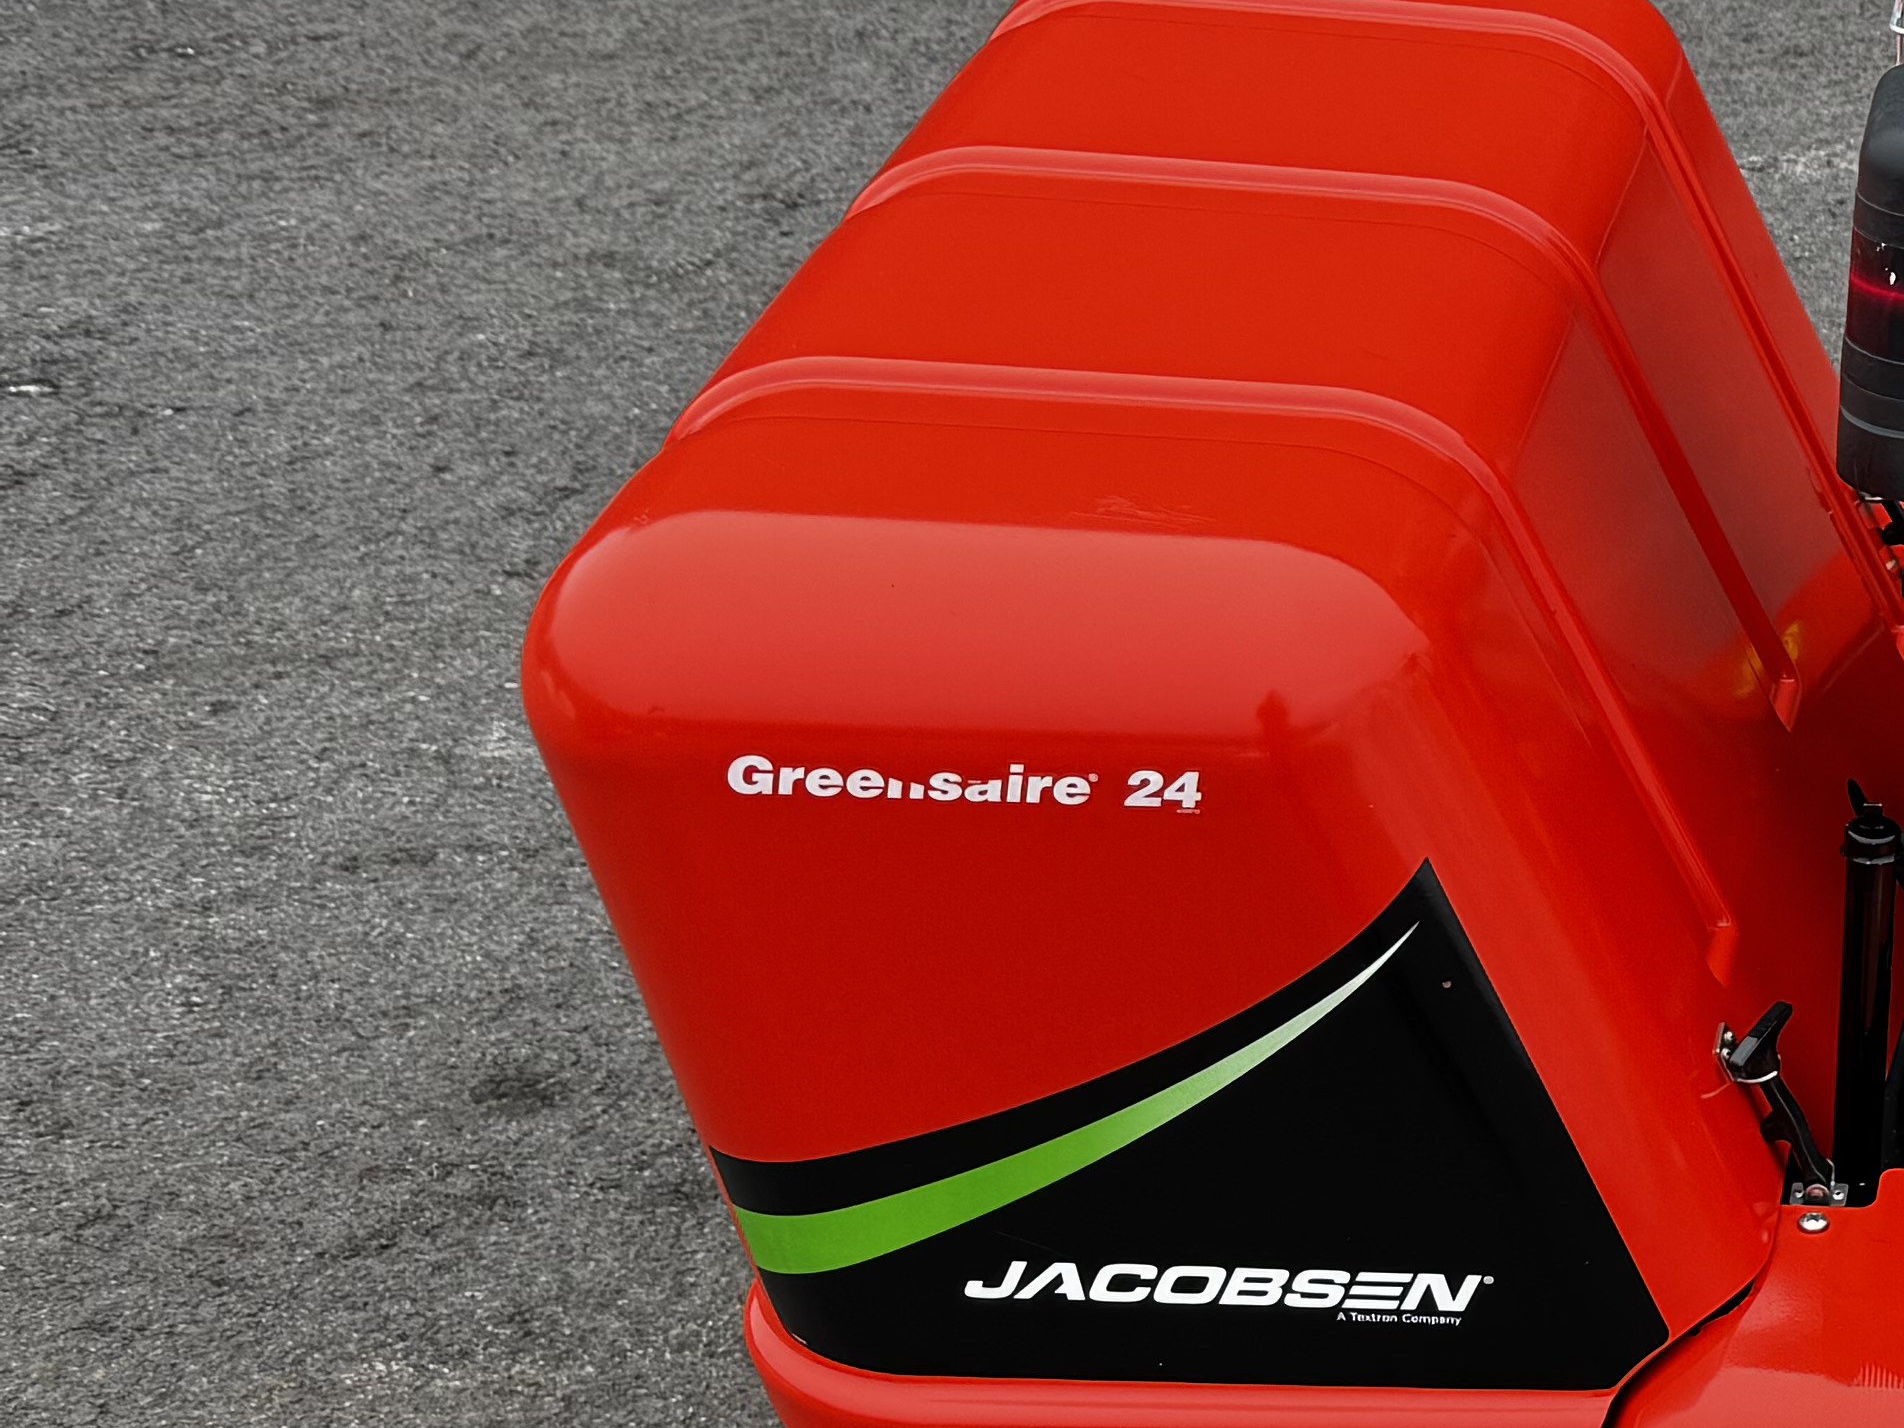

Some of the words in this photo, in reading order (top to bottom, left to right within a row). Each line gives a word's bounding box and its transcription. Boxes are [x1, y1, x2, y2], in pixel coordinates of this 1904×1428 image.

[1124, 770, 1202, 809] 24
[964, 1260, 1483, 1313] JACOBSEN
[1336, 1311, 1346, 1322] A
[1349, 1312, 1398, 1323] Textron
[1401, 1313, 1462, 1327] Company
